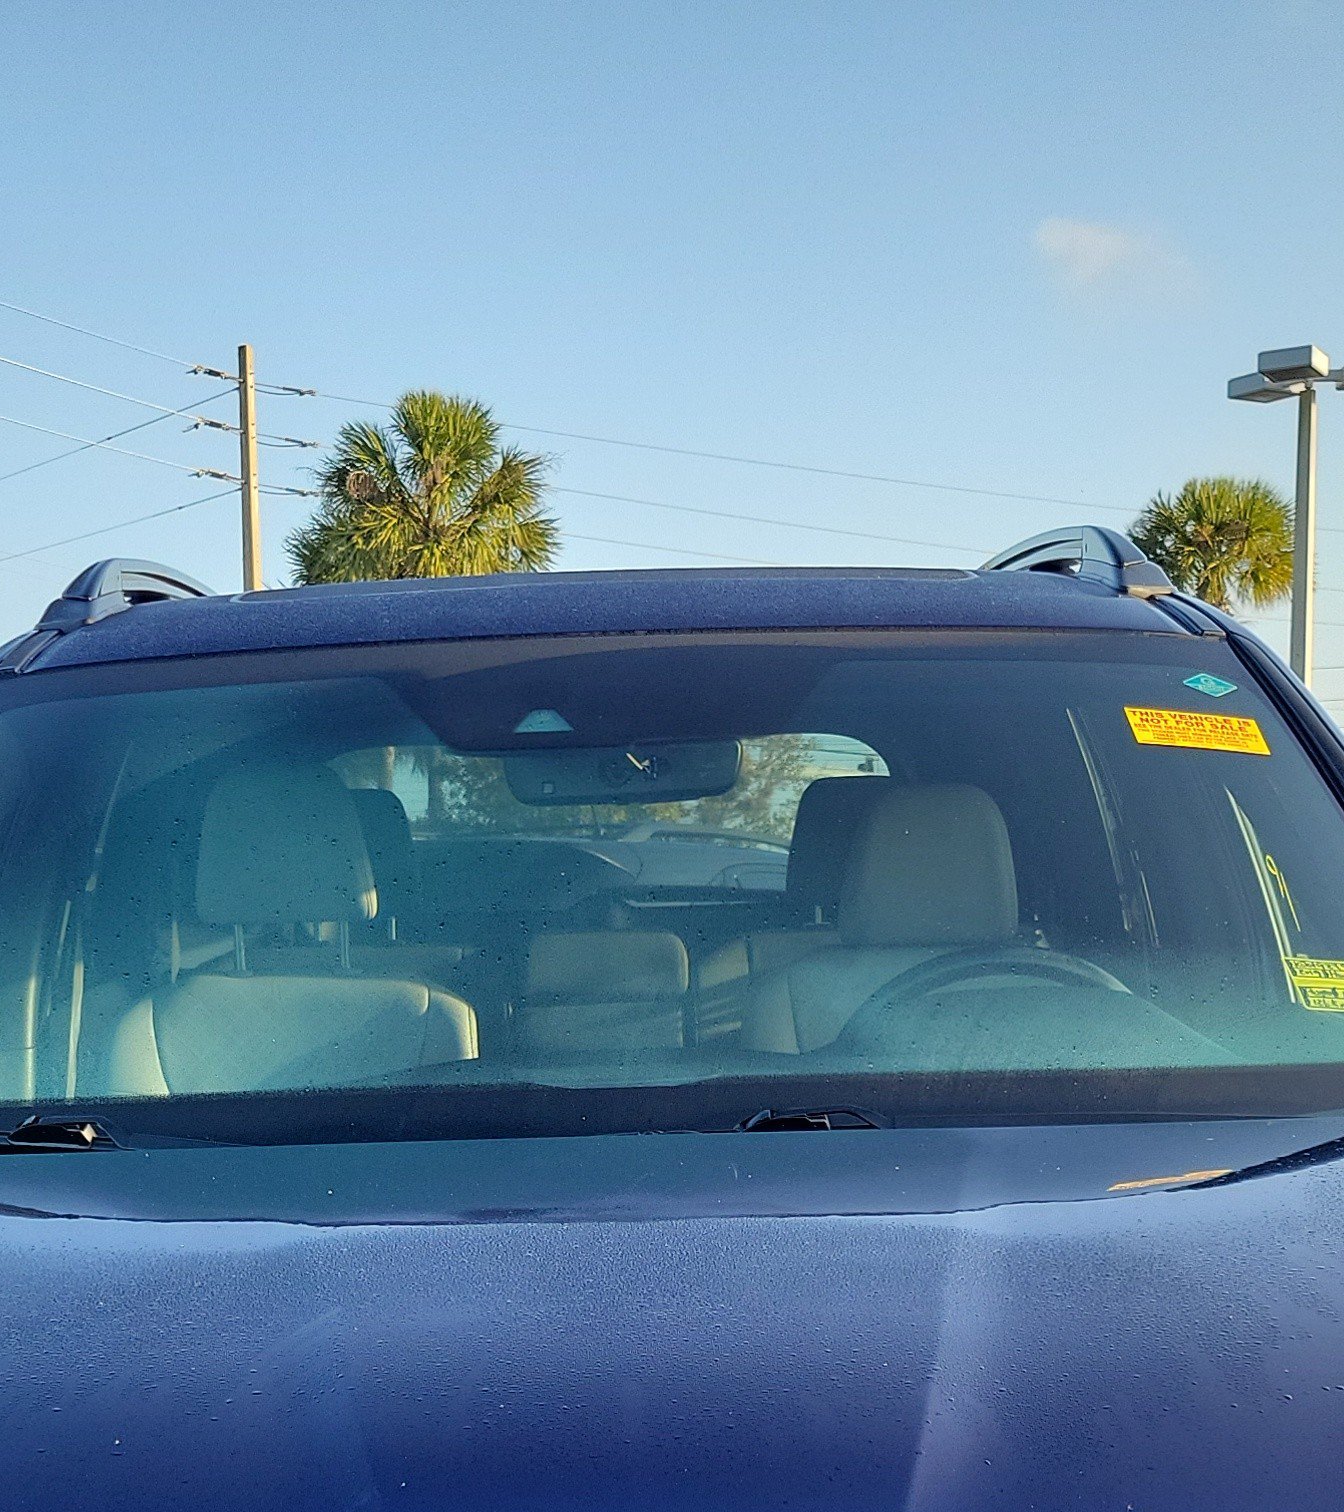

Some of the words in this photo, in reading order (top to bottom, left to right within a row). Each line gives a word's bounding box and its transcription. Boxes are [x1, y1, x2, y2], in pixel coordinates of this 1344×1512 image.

[1131, 710, 1164, 719] THIS
[1167, 712, 1232, 726] VEHICLE
[1238, 719, 1252, 728] IS
[1139, 717, 1170, 727] NOT
[1175, 719, 1206, 729] FOR
[1210, 723, 1248, 733] SALE
